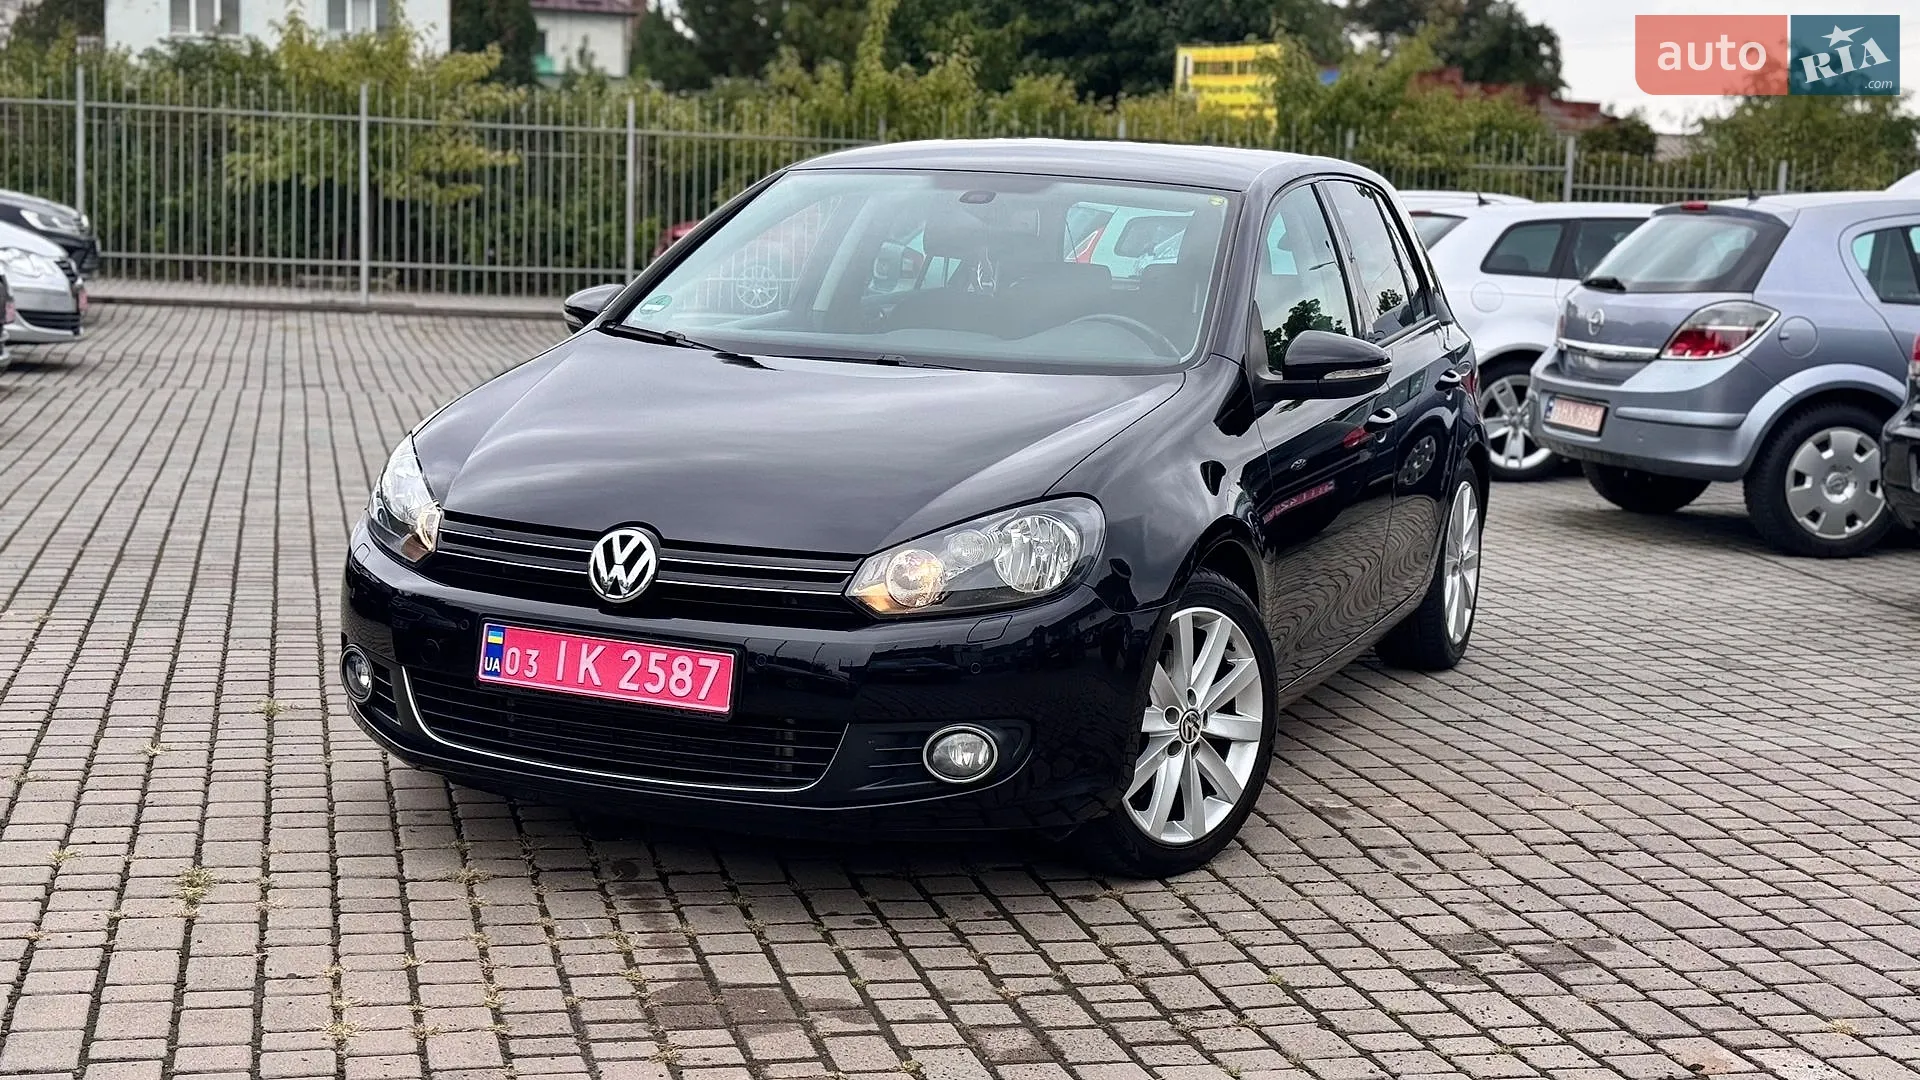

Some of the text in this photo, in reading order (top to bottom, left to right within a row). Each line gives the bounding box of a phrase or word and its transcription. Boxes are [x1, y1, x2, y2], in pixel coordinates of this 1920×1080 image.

[484, 656, 501, 673] UA
[505, 640, 721, 701] 03 IK 2587
